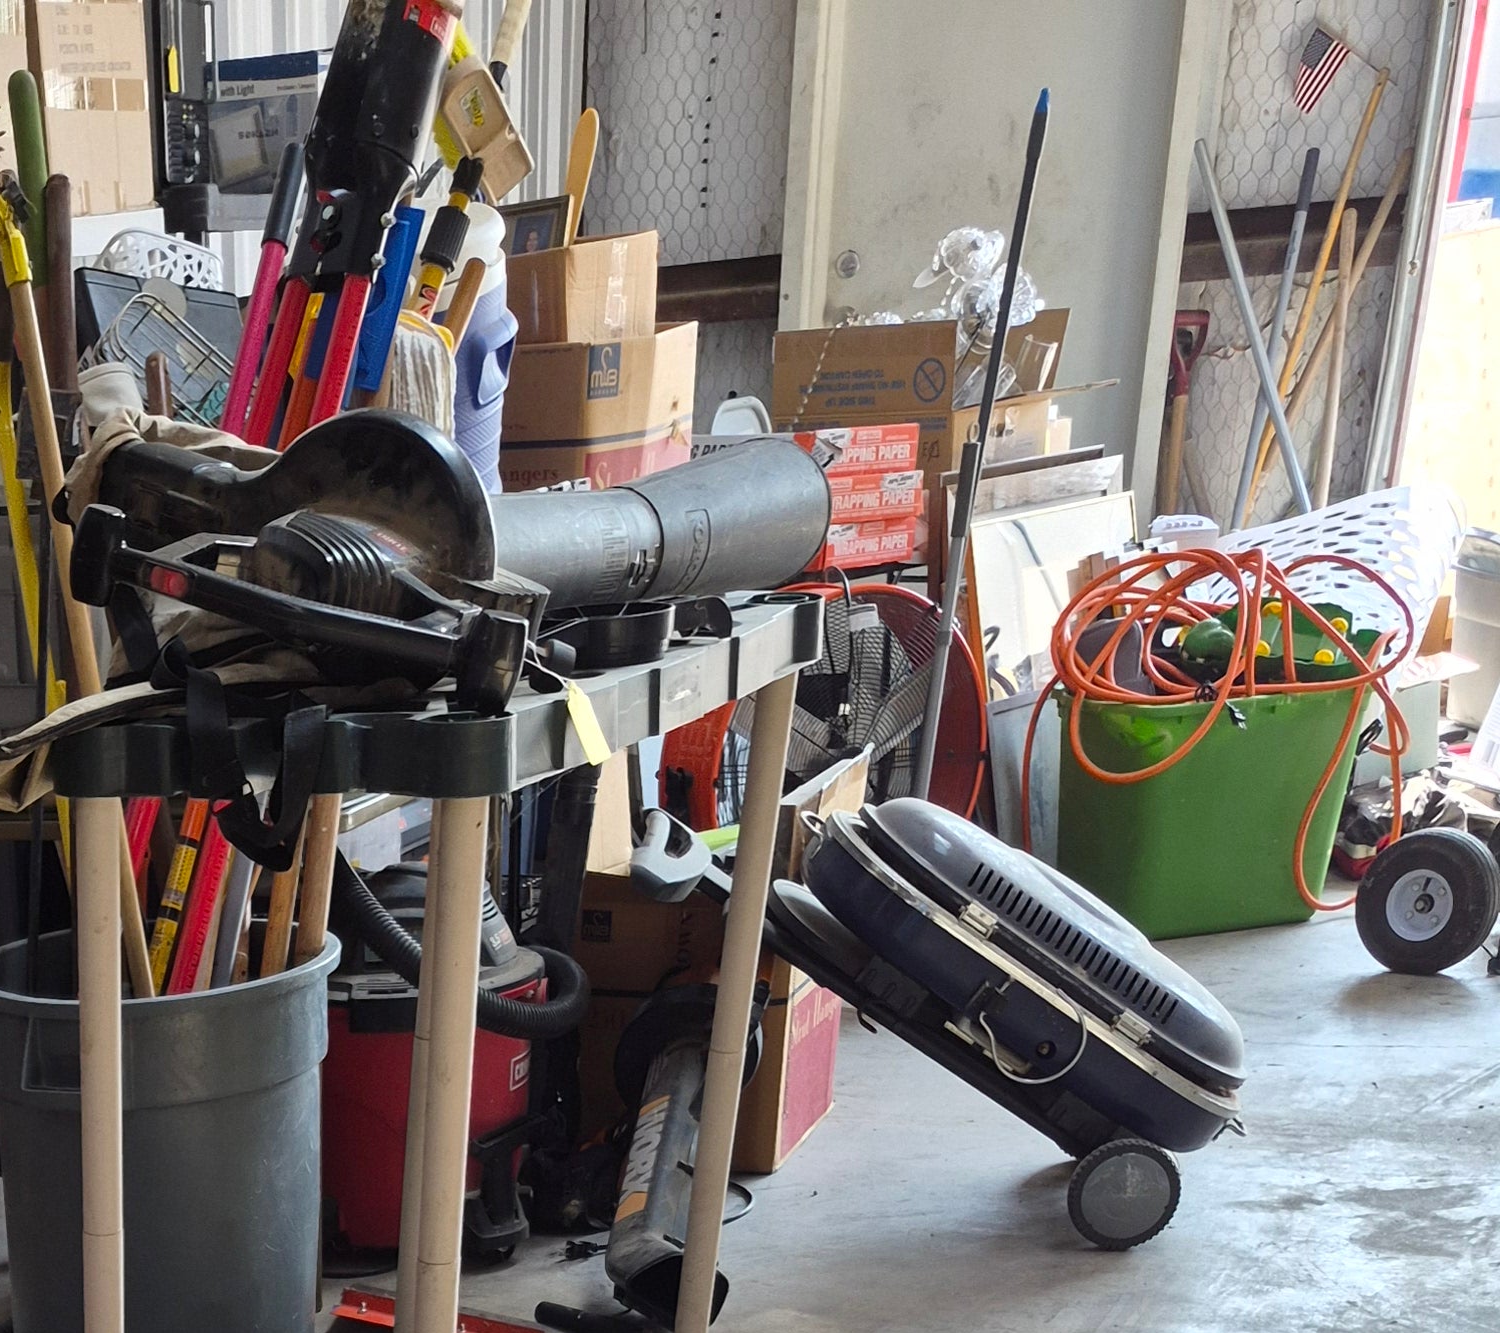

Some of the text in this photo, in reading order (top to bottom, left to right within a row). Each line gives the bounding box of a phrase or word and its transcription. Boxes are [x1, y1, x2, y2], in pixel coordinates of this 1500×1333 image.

[221, 84, 255, 97] with Light
[878, 444, 911, 460] PAPER
[882, 489, 915, 506] PAPER
[881, 533, 909, 550] PAPER
